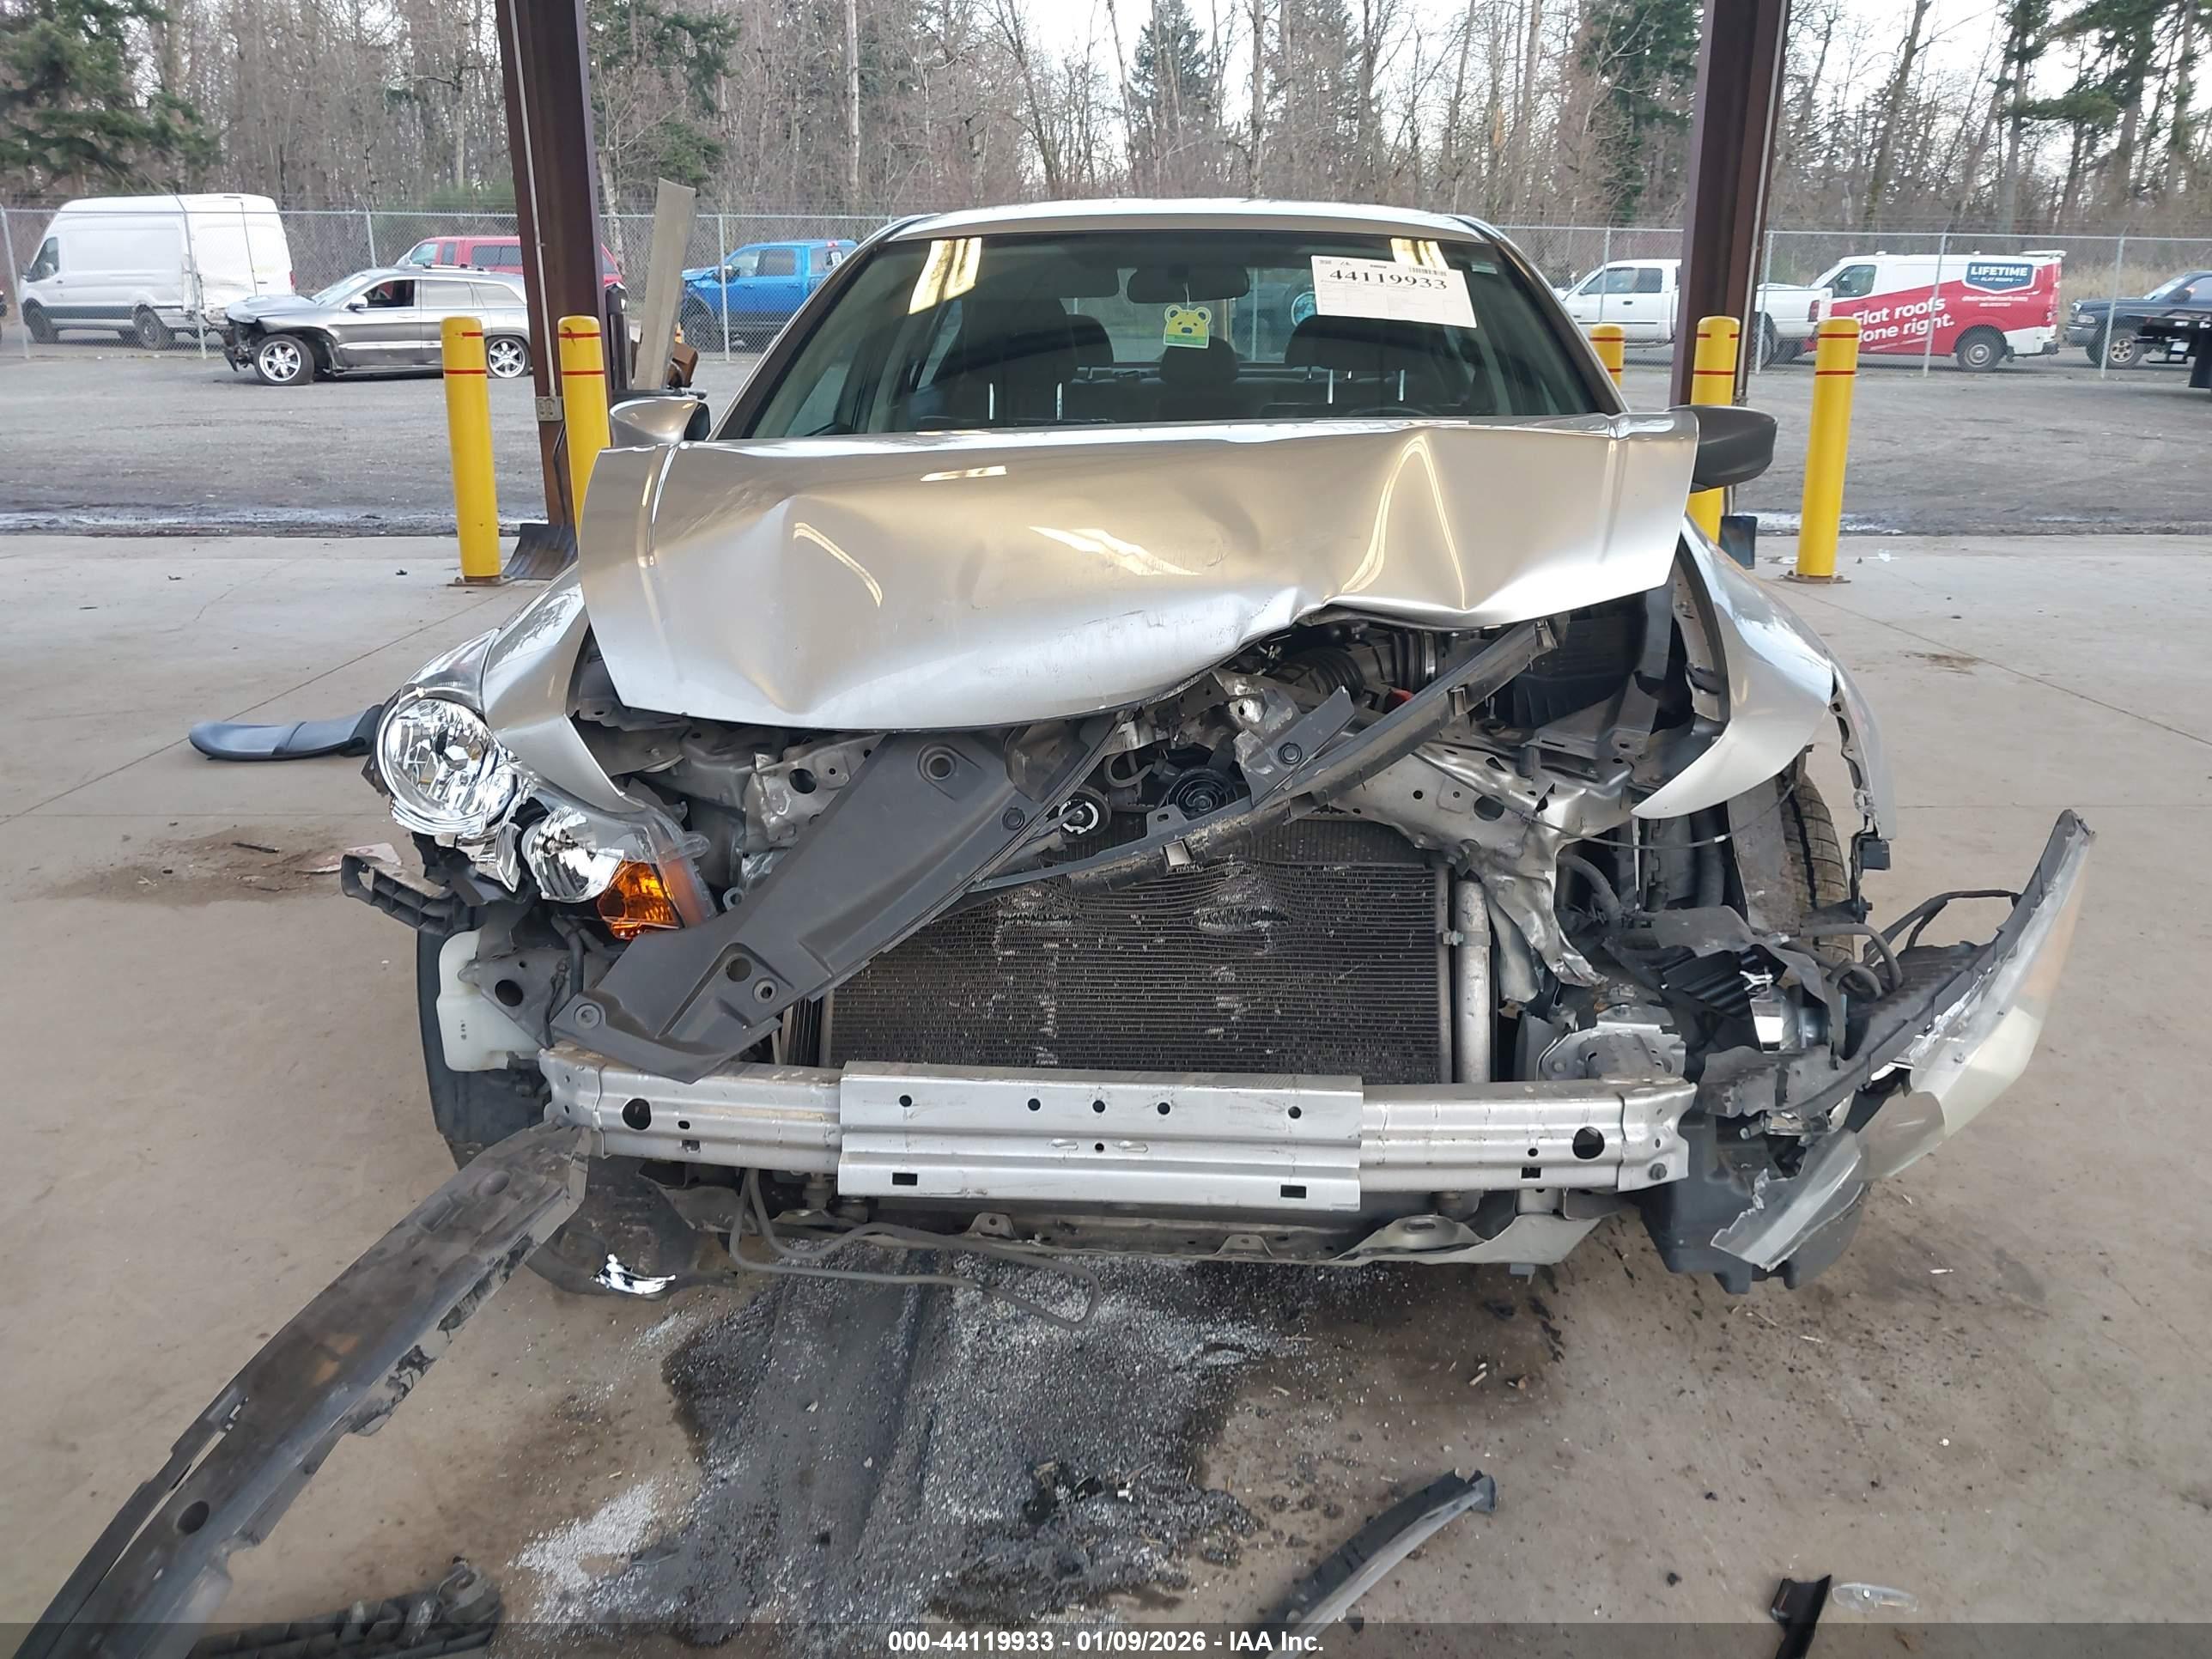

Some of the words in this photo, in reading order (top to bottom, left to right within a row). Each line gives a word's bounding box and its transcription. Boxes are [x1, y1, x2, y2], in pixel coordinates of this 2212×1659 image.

[1329, 270, 1448, 290] 44119933
[1970, 265, 2028, 276] LIFETIME
[1852, 307, 1891, 325] Flat
[1894, 296, 1947, 319] roofs
